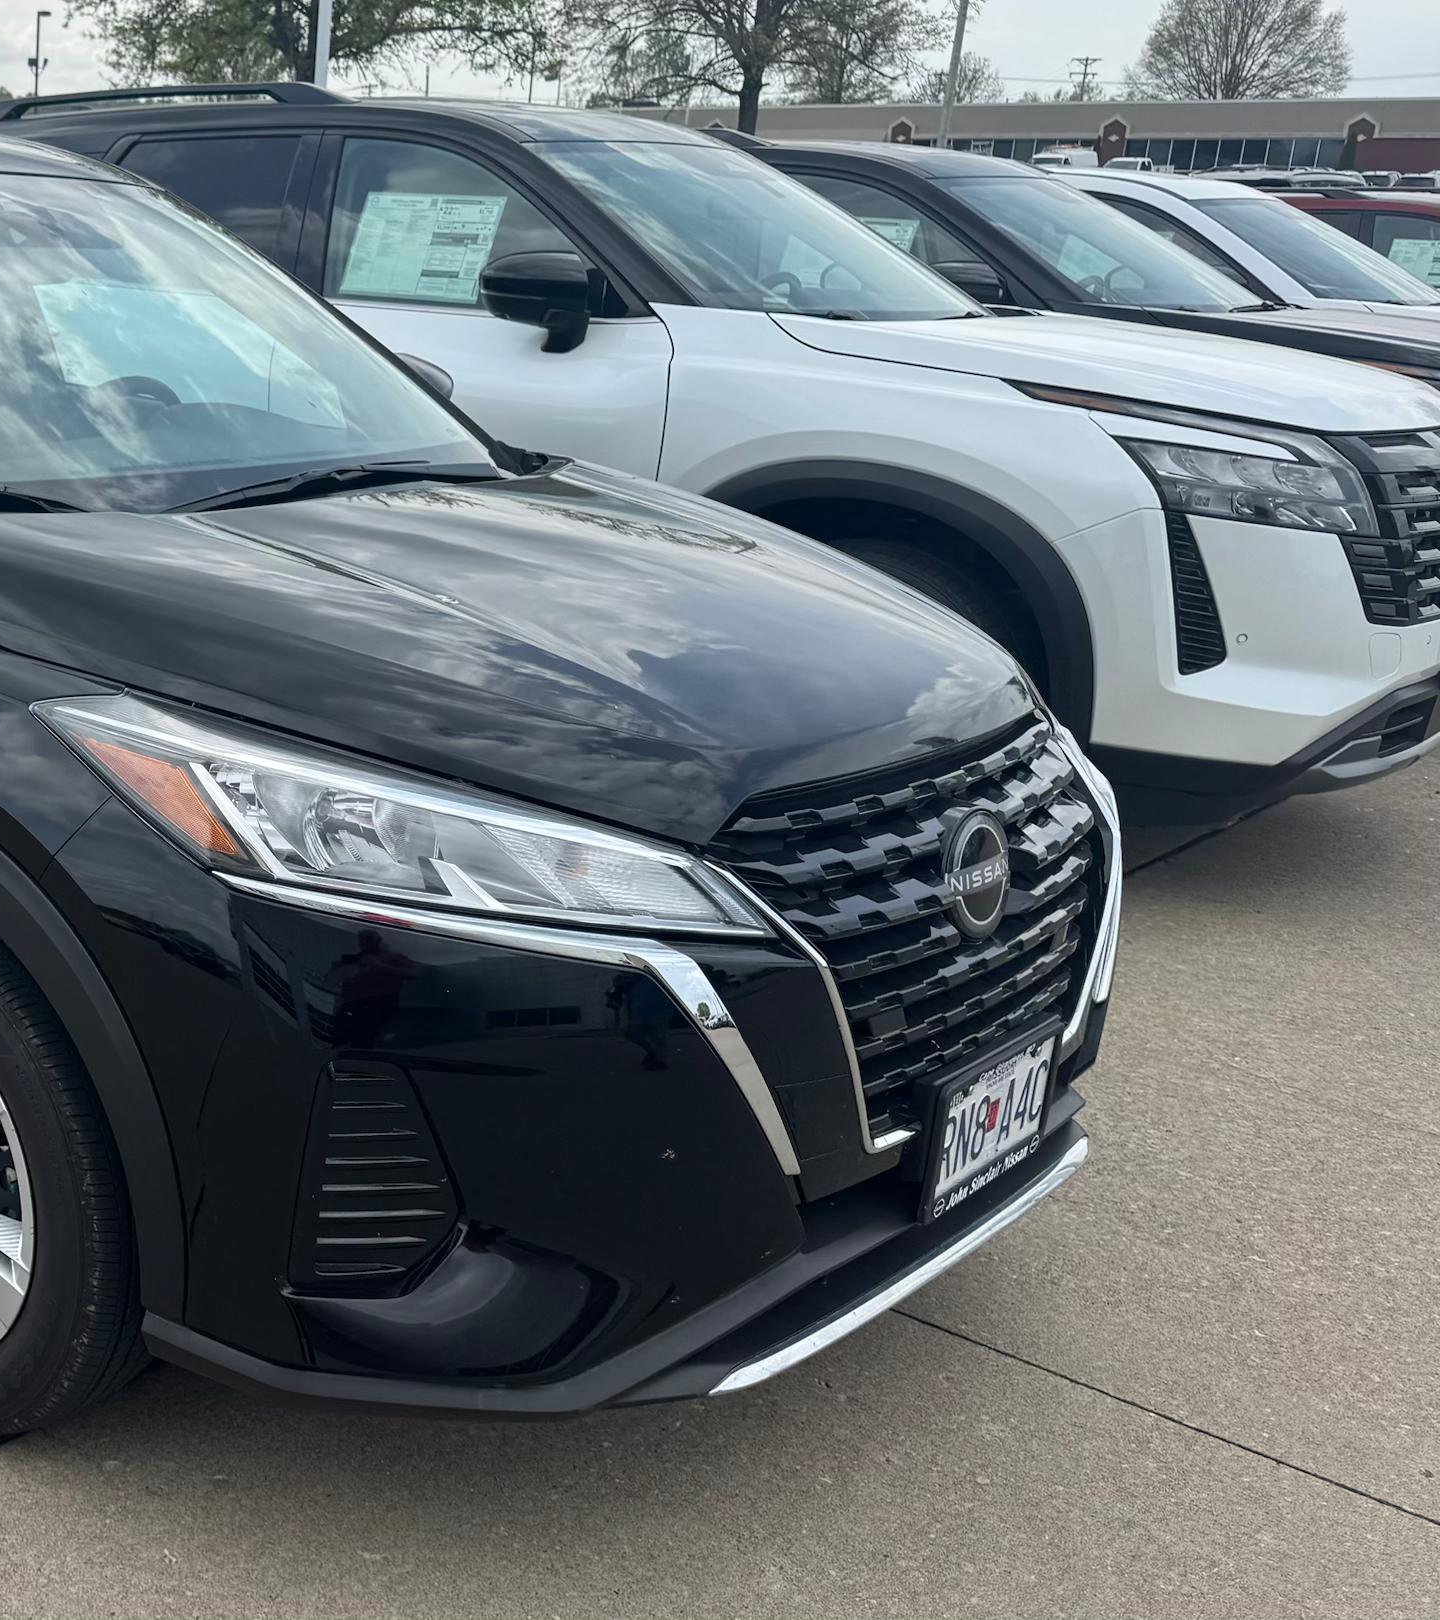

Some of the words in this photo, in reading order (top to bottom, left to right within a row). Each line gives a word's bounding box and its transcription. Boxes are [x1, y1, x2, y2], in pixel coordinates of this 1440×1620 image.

[950, 858, 1009, 892] NISSAN
[945, 1186, 969, 1211] John
[969, 1161, 1002, 1195] Sinclair
[1001, 1145, 1029, 1174] Nissan
